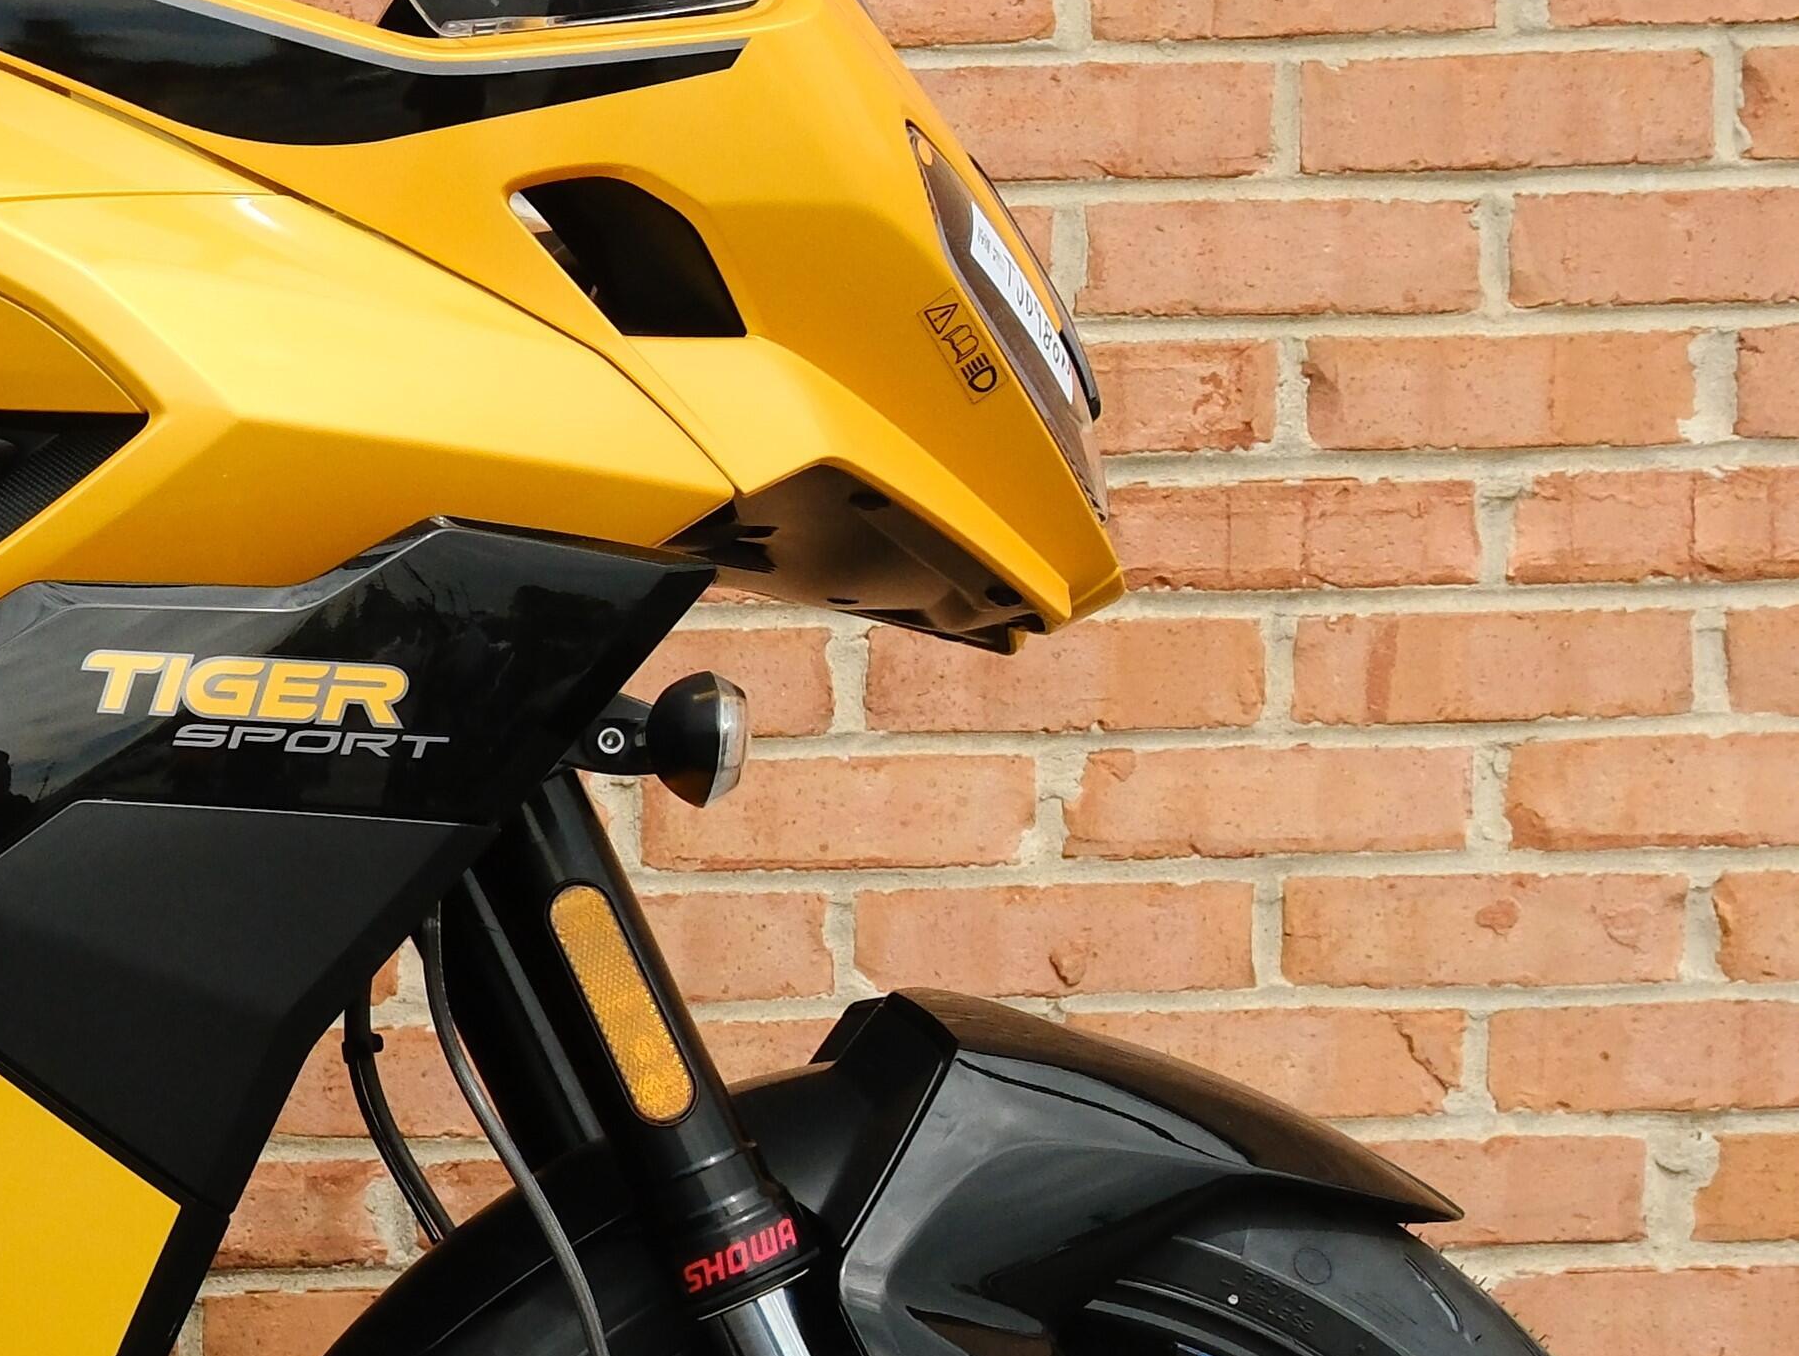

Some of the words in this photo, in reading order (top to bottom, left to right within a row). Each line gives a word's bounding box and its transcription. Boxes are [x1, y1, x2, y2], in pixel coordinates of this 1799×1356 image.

[81, 649, 410, 729] TIGER
[172, 724, 450, 759] SPORT
[682, 1218, 798, 1293] SHOWA
